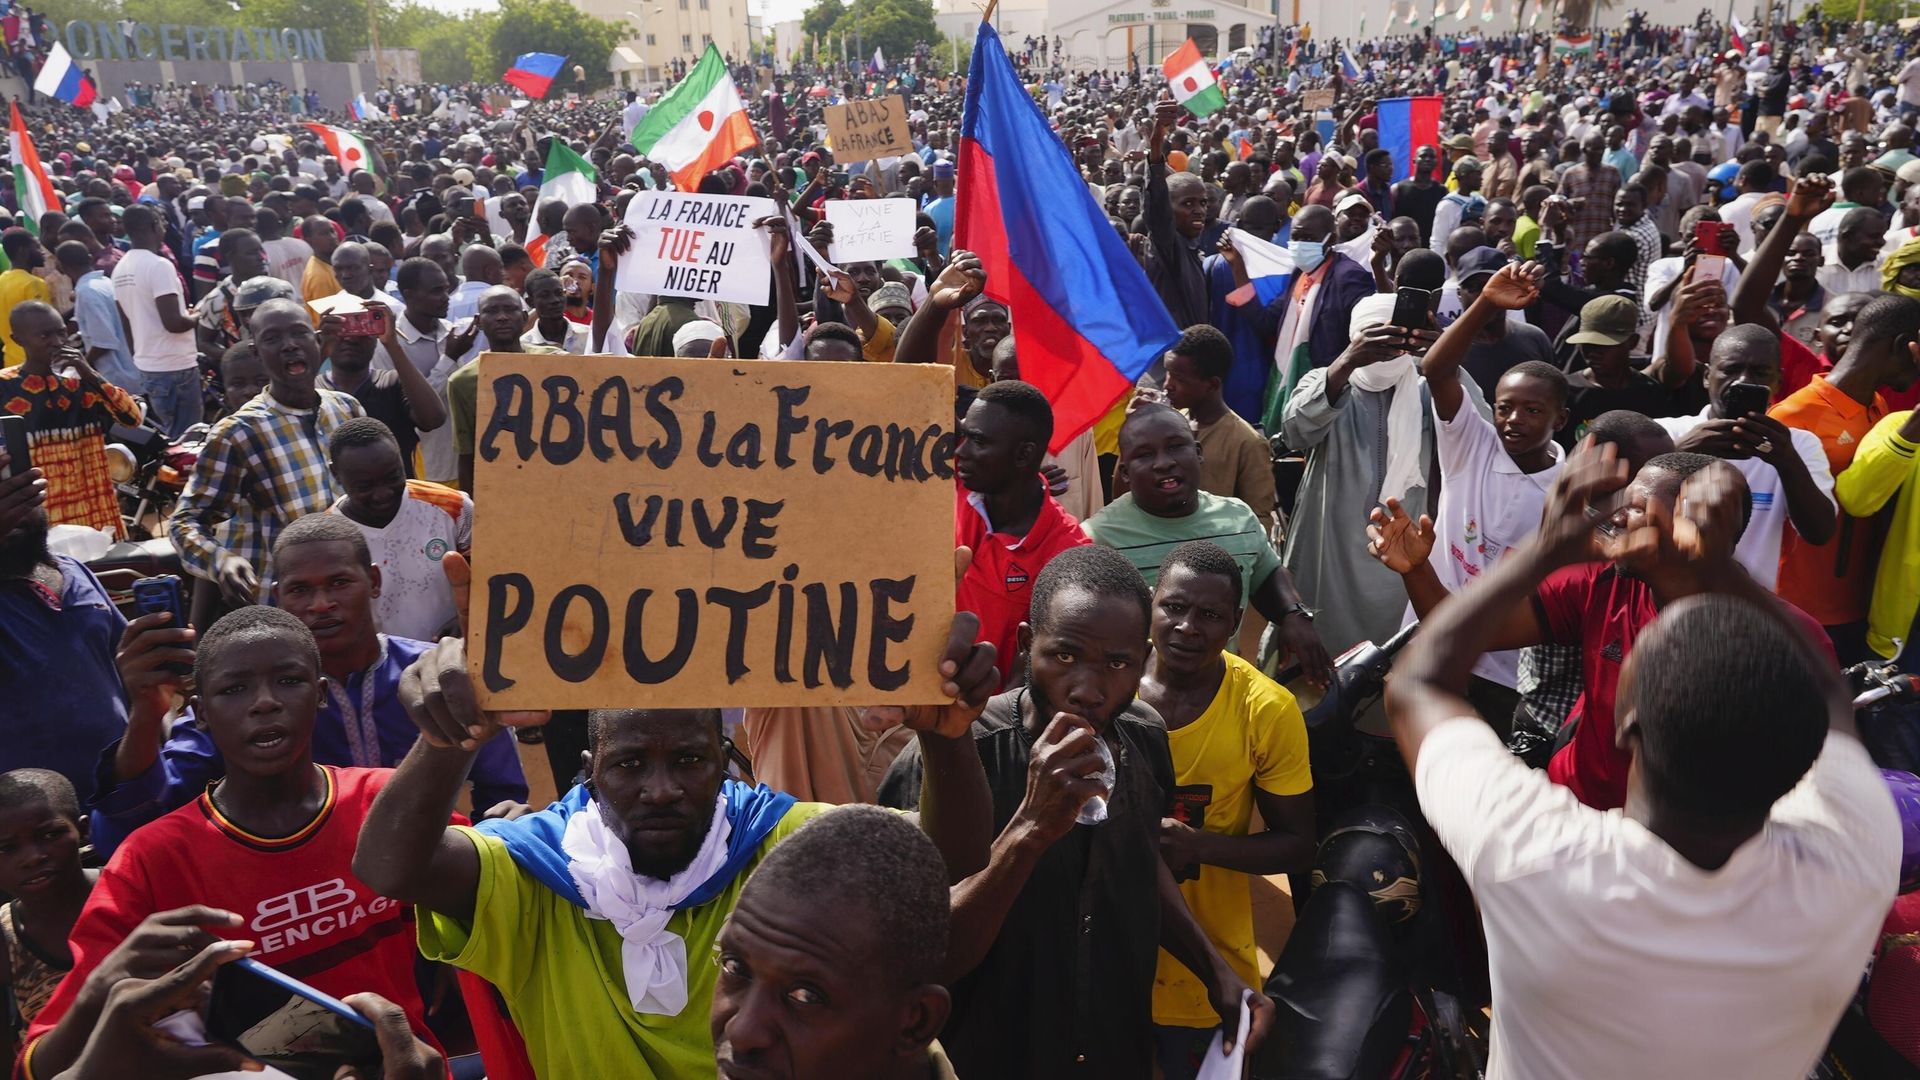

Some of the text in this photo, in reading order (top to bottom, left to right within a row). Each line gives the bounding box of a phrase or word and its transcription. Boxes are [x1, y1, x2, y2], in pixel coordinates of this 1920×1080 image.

[1153, 11, 1178, 20] TRAVAIL
[845, 99, 890, 130] ABAS
[834, 126, 895, 152] LA FRANCE
[647, 198, 750, 229] LA FRANCE
[848, 203, 895, 218] VIVE
[858, 220, 882, 232] LA
[657, 227, 735, 266] TUE AU
[663, 266, 722, 294] NIGER
[479, 373, 686, 470] ABAS
[770, 384, 956, 483] France
[613, 492, 785, 559] VIVE
